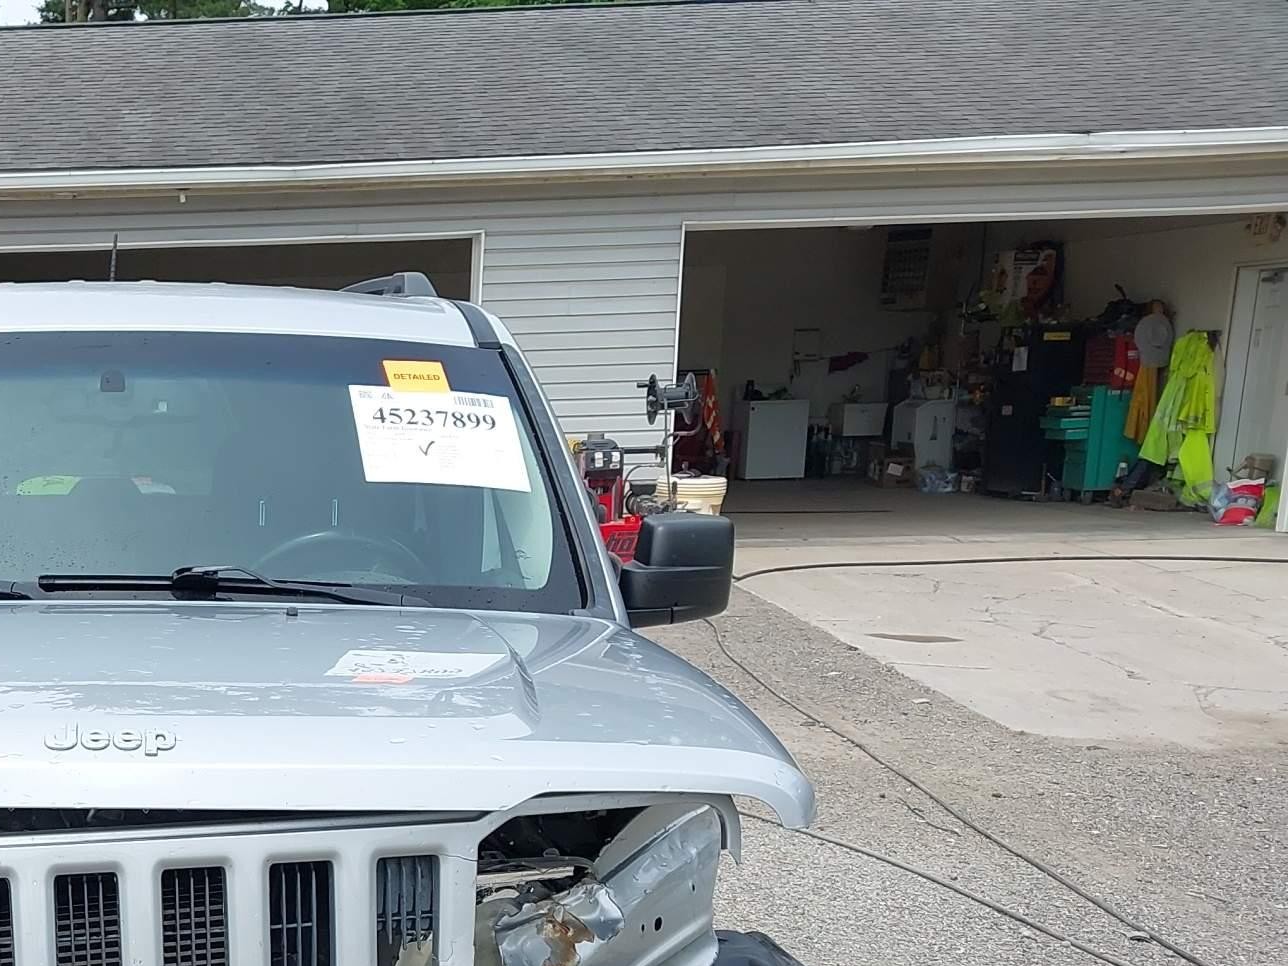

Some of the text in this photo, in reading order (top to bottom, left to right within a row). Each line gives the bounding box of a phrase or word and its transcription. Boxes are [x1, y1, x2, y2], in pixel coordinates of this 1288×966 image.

[393, 373, 441, 381] DETAILED
[372, 406, 497, 431] 45237899
[43, 721, 177, 757] Jeep
